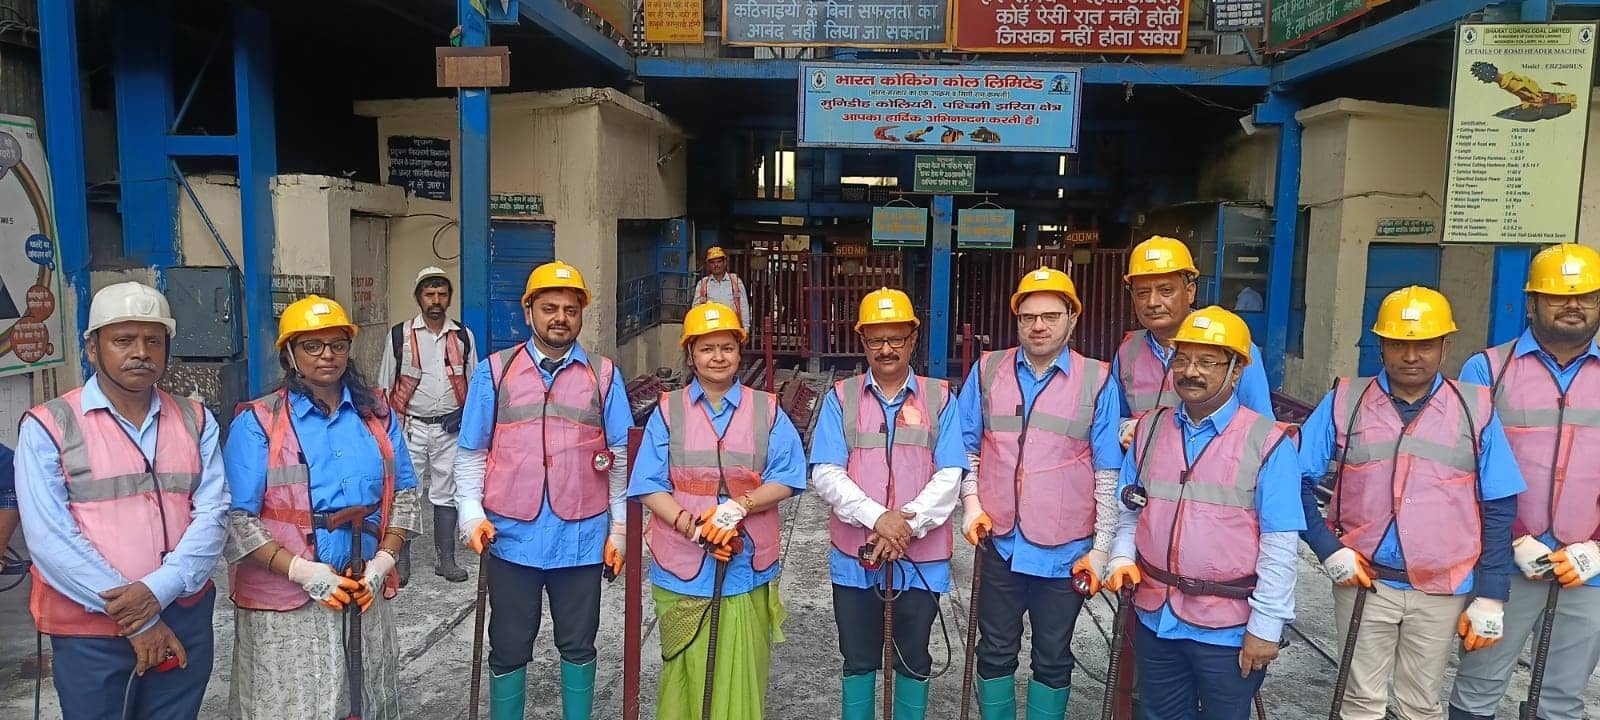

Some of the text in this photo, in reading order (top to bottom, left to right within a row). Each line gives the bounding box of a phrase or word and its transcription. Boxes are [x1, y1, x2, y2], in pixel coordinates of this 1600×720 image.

[859, 3, 912, 18] सफलता
[917, 3, 938, 18] का
[996, 4, 1031, 25] कोई
[1036, 4, 1070, 25] ऐसी
[1074, 9, 1105, 25] रात
[1147, 4, 1182, 28] होती
[748, 22, 785, 40] आनंद
[791, 19, 818, 40] नहीं
[824, 19, 858, 39] लिया
[862, 24, 882, 39] जा
[996, 25, 1181, 46] जिसका नहीं होता सवेरा
[836, 72, 1045, 90] भारत कोकिंग कोल लिमिटेड
[820, 97, 870, 110] मुनिडीह
[943, 100, 991, 110] पश्चिमी
[995, 102, 1035, 111] झरिया
[1040, 102, 1063, 112] क्षेत्र
[842, 112, 881, 122] आपका
[886, 112, 922, 122] हार्दिक
[926, 112, 985, 124] अभिनन्दन
[988, 114, 1020, 124] करती
